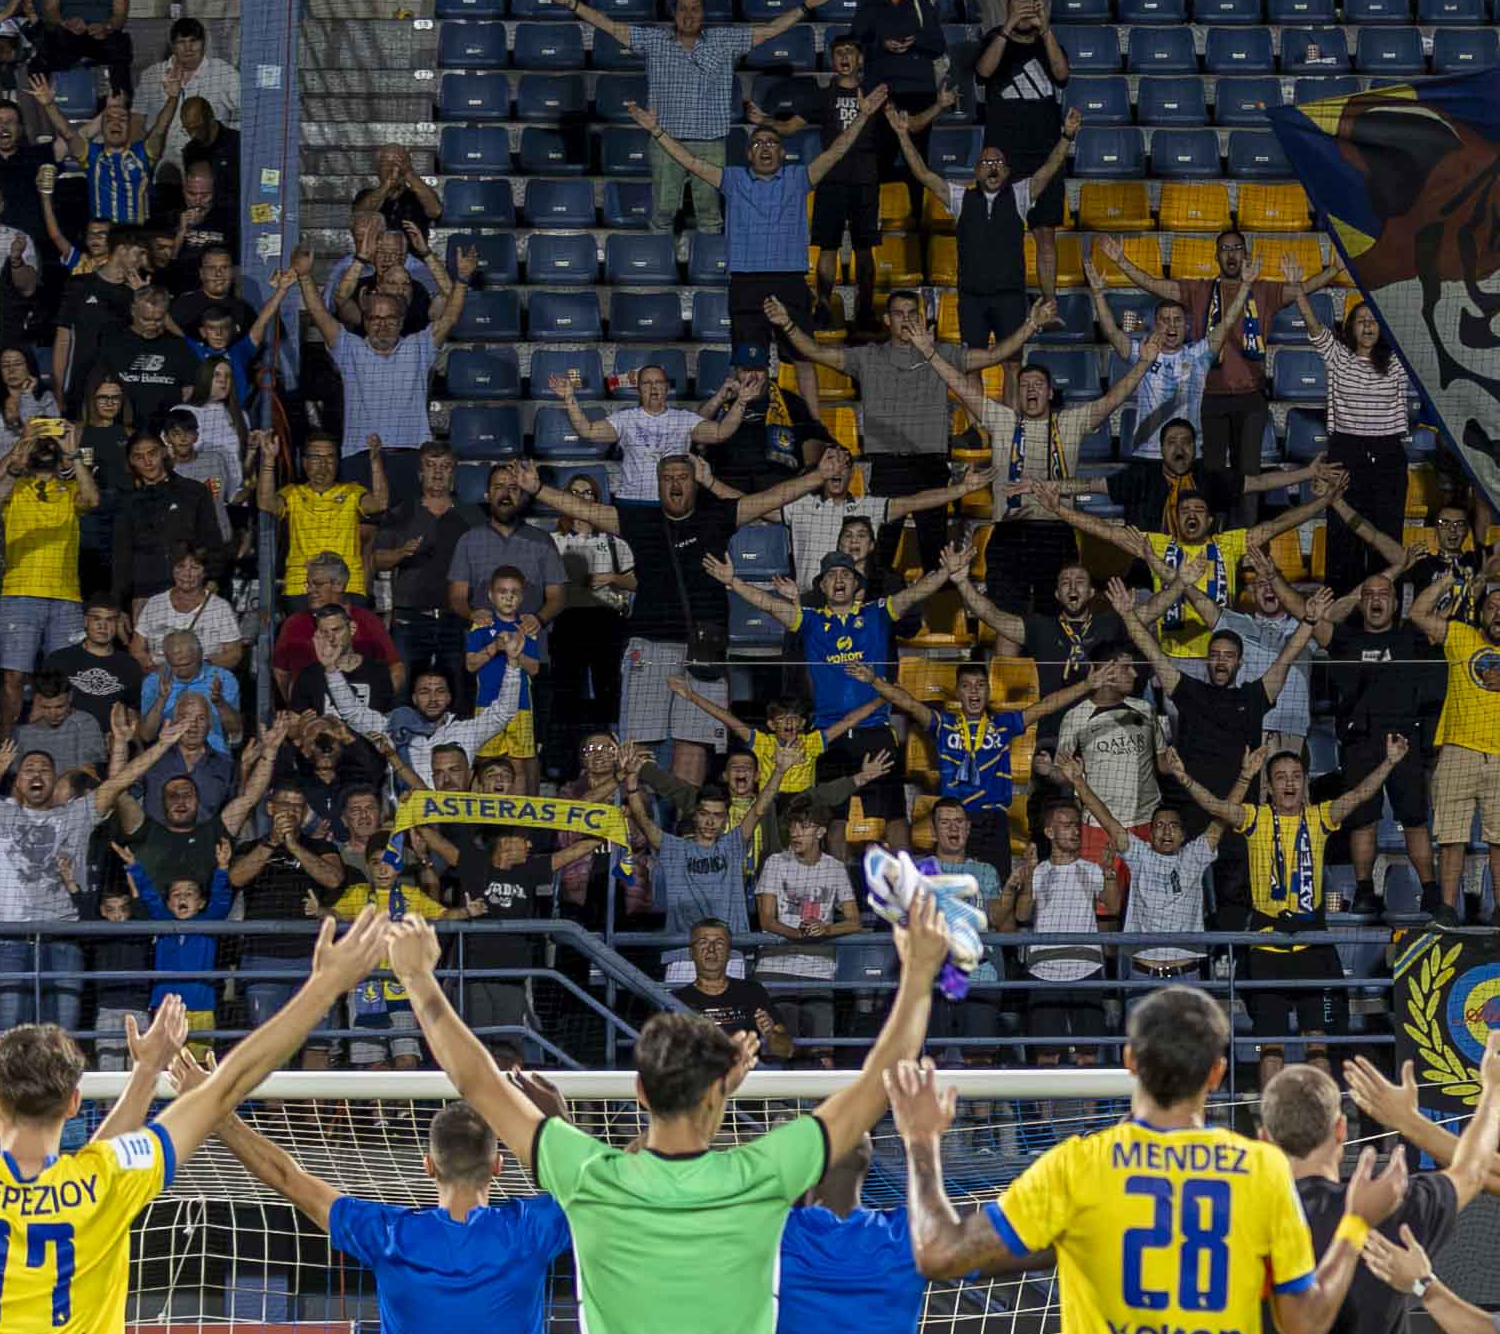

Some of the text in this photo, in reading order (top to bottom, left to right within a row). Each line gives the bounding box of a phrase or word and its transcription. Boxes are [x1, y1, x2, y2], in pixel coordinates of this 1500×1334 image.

[836, 97, 859, 109] JUS
[1097, 733, 1146, 753] QATAR
[422, 797, 606, 830] ASTERAS FC
[1299, 833, 1313, 913] ΑΣΤΕΡ
[1112, 1140, 1250, 1176] MENDEZ
[1122, 1175, 1231, 1314] 28
